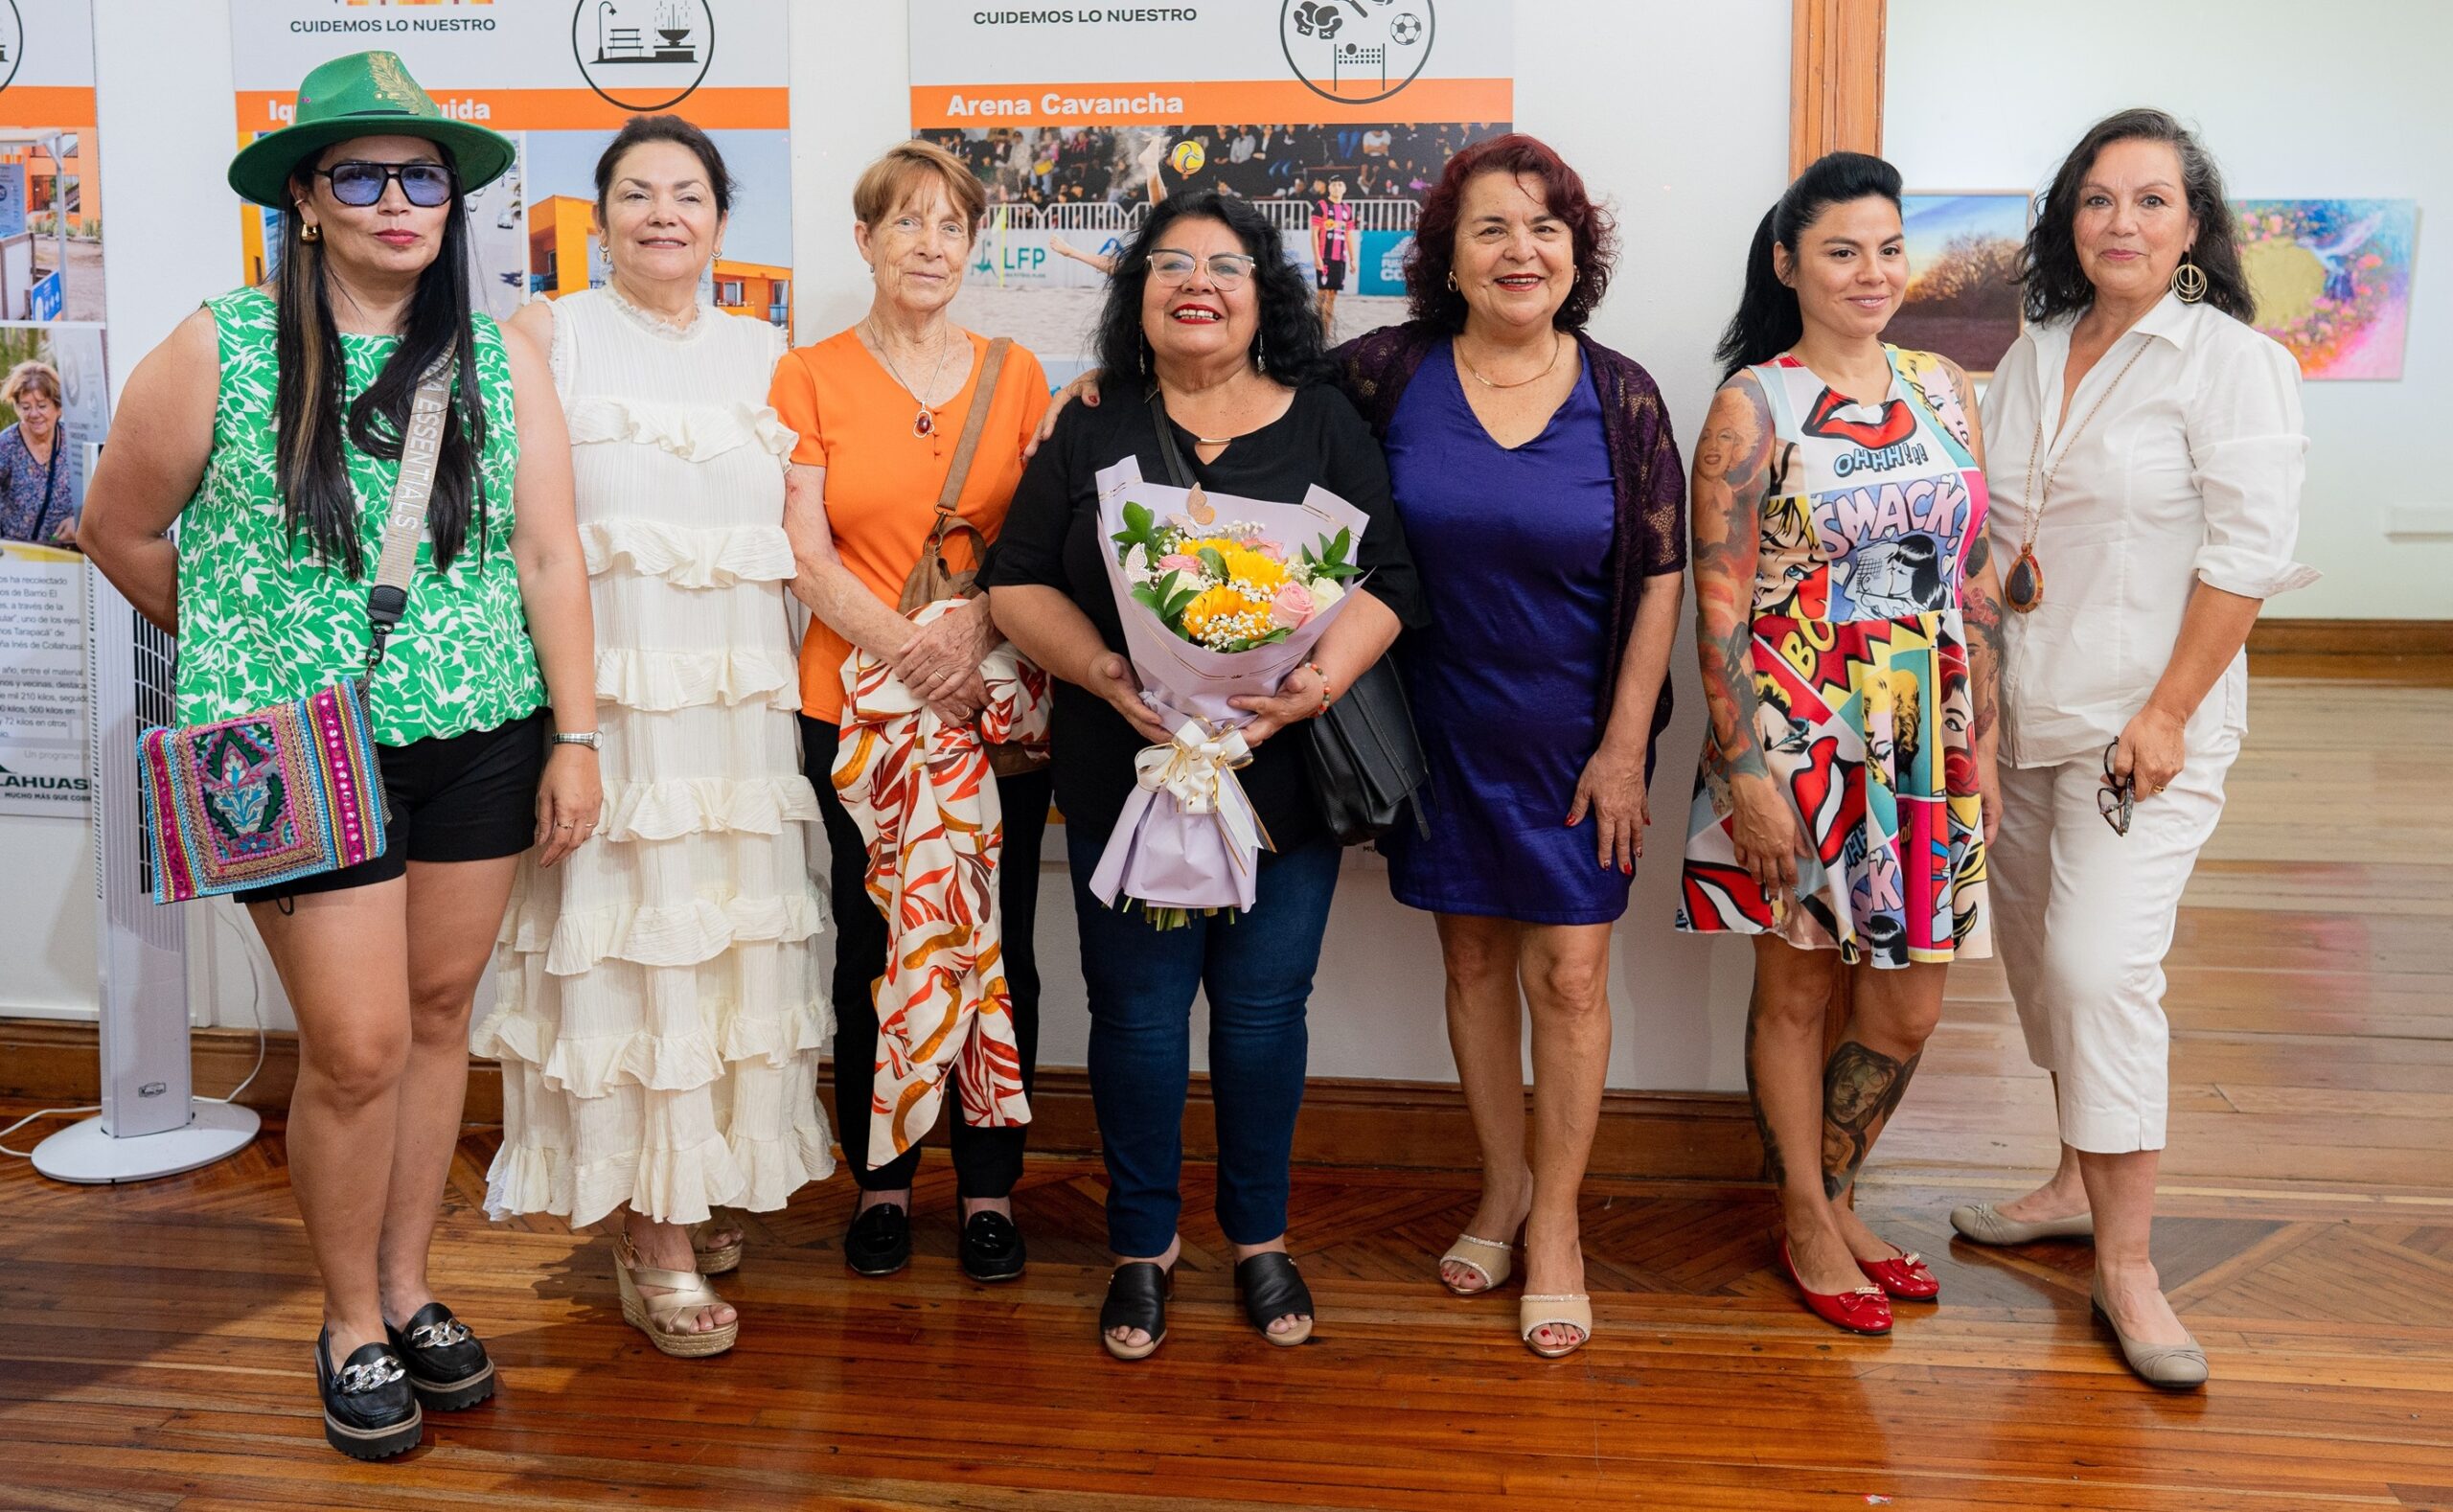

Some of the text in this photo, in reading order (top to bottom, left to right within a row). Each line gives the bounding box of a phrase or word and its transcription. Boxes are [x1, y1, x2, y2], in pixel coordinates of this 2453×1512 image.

[973, 8, 1198, 25] CUIDEMOS LO NUESTRO
[290, 18, 496, 33] CUIDEMOS LO NUESTRO
[947, 92, 1184, 117] Arena Cavancha
[1003, 247, 1046, 270] LFP
[394, 397, 442, 531] ESSENTIALS
[23, 588, 47, 598] Barrio
[44, 603, 55, 611] de
[50, 616, 62, 625] los
[55, 629, 65, 637] de
[30, 640, 40, 650] de
[21, 667, 41, 676] entre
[43, 667, 50, 676] el
[52, 668, 83, 676] material
[46, 706, 63, 715] kilos
[16, 718, 34, 726] kilos
[24, 750, 37, 759] Un
[38, 751, 80, 762] programa
[0, 775, 92, 791] AHUAS
[5, 791, 33, 800] MUCHO
[34, 791, 51, 801] MÁS
[53, 793, 68, 802] QUE
